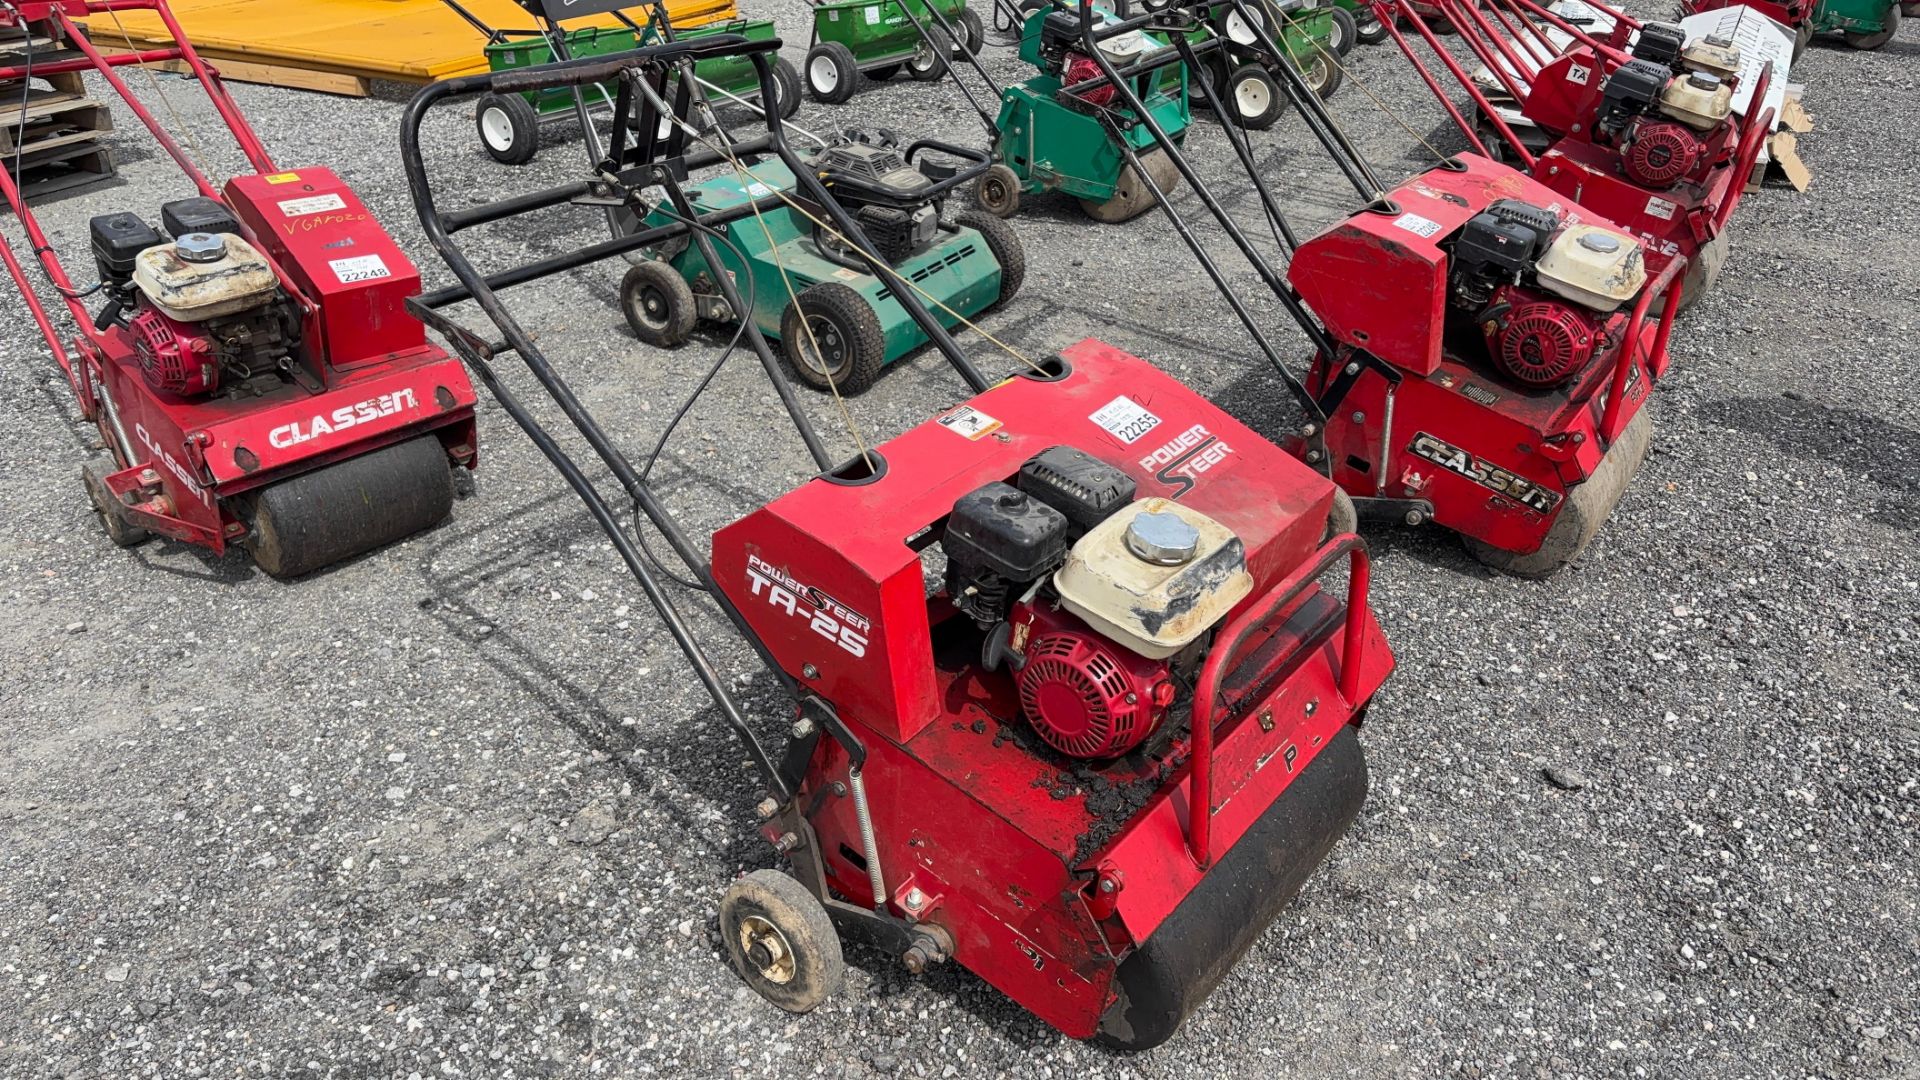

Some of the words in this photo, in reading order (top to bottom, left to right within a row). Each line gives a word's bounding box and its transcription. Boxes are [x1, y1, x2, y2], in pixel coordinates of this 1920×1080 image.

[343, 268, 387, 282] 22248
[269, 388, 415, 448] CLASSEN
[1119, 413, 1158, 442] 22255
[1138, 424, 1210, 472] POWER
[135, 423, 211, 510] CLASSEN
[1156, 436, 1234, 500] STEER
[1415, 436, 1546, 509] CLASSEN
[746, 568, 868, 658] TA-25
[748, 554, 808, 597] POWER
[807, 586, 871, 636] STEER
